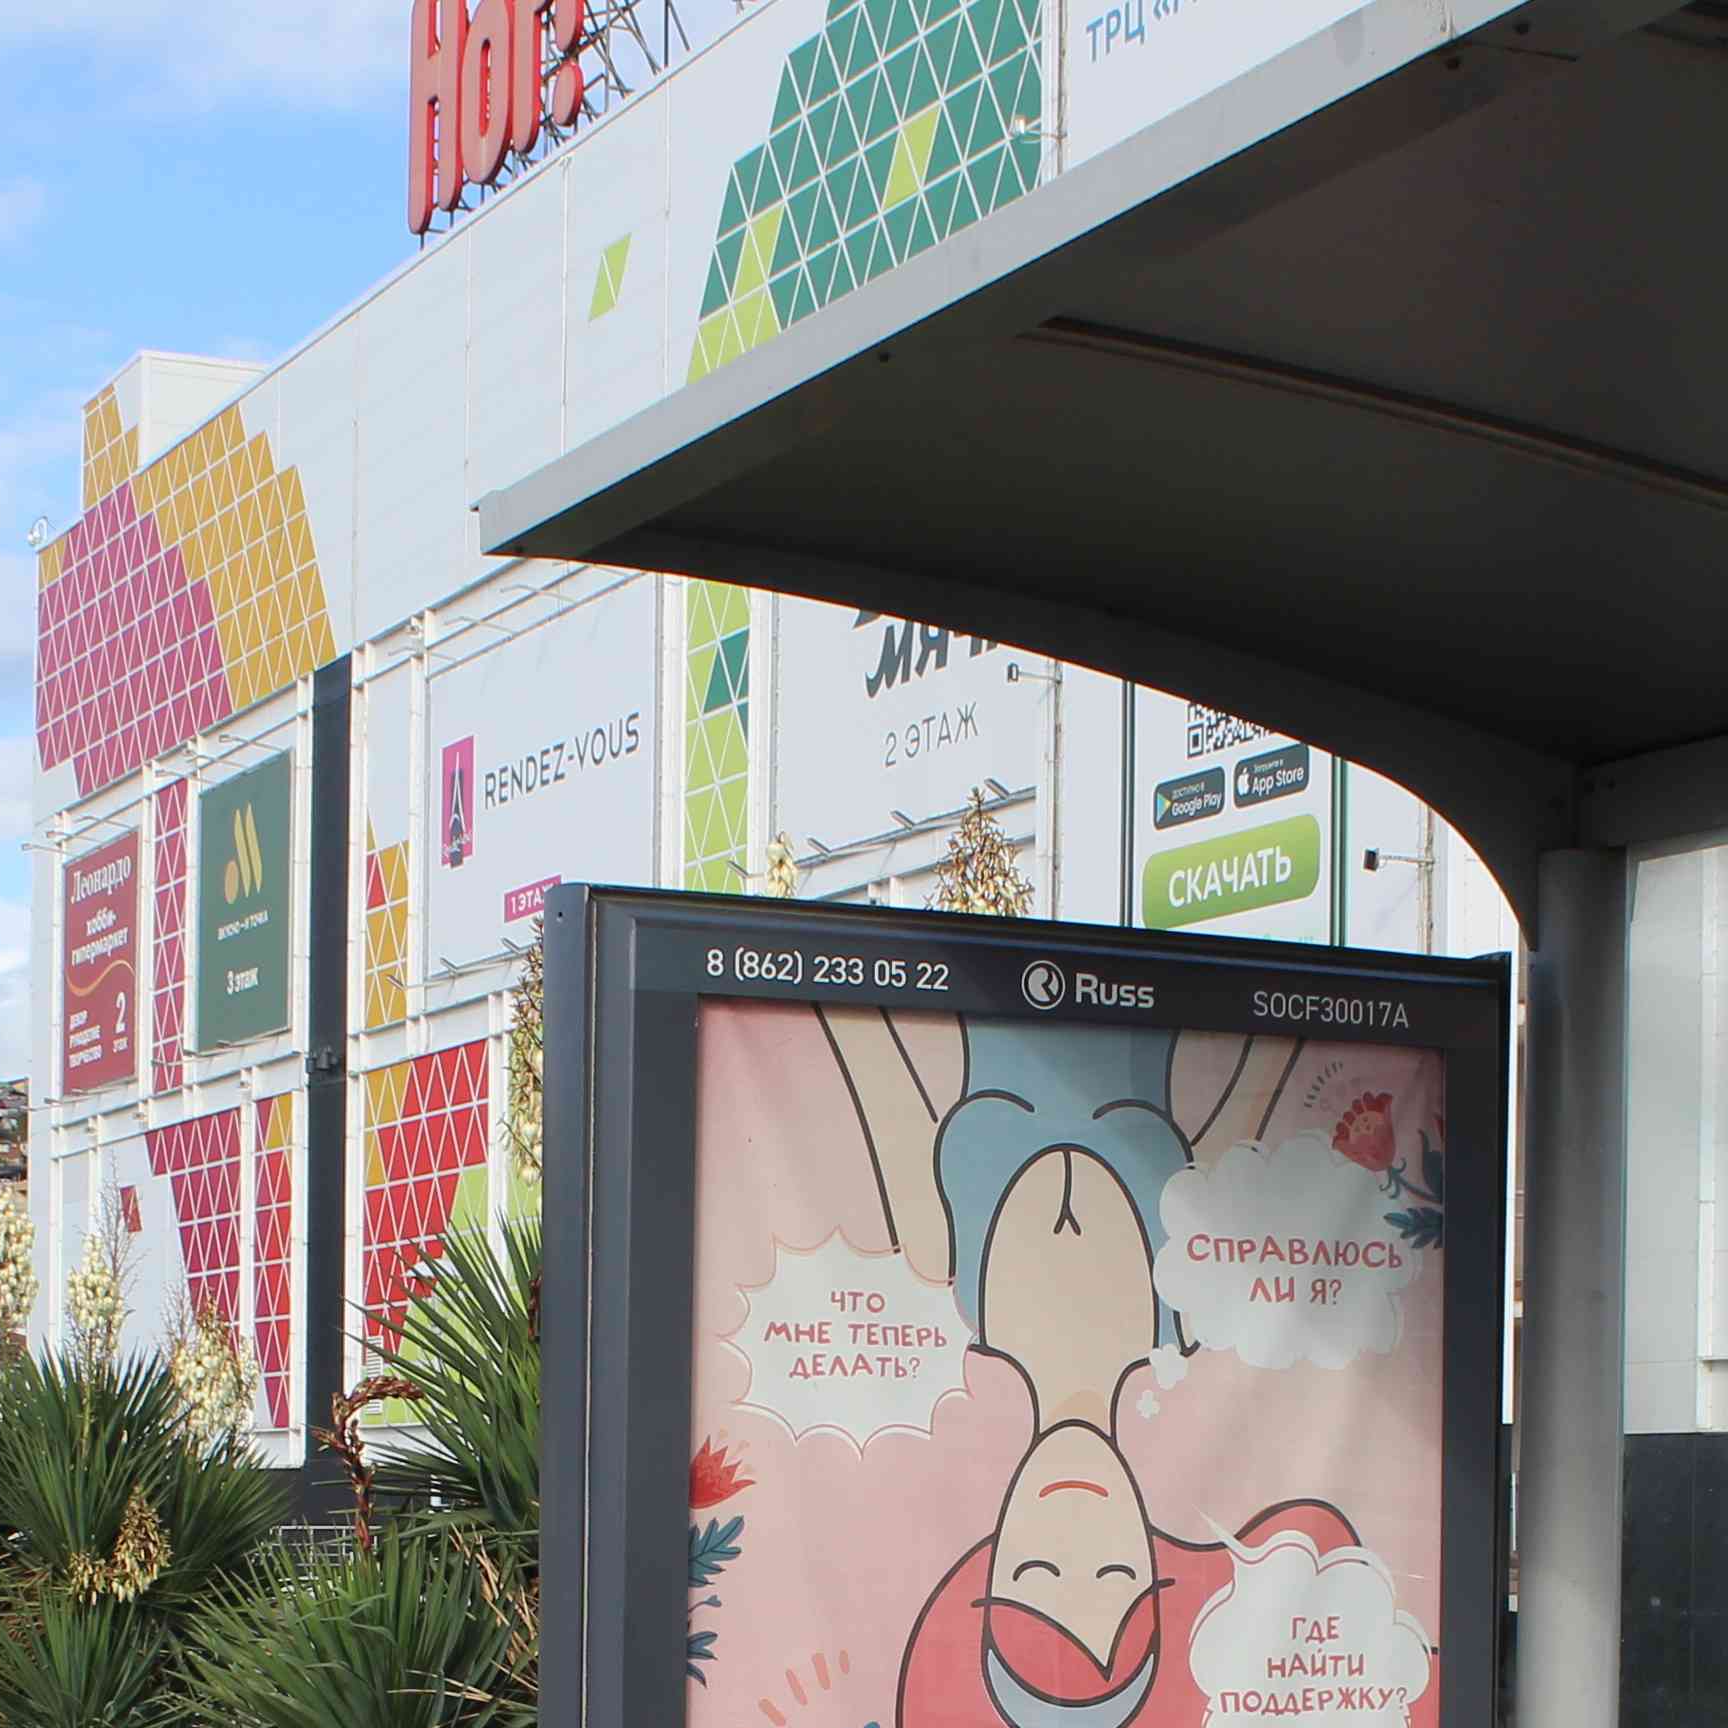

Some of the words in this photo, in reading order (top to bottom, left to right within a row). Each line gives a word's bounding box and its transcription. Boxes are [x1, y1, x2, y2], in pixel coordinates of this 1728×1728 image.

[885, 731, 897, 767] 2
[905, 701, 979, 758] ЭТАЖ
[484, 711, 640, 810] RENDEZ-VOUS
[1251, 776, 1273, 796] App
[1275, 766, 1304, 788] Store
[1172, 797, 1202, 817] Google
[1203, 792, 1222, 810] Play
[71, 856, 132, 904] Леонардо
[1169, 846, 1292, 908] СКАЧАТЬ
[706, 953, 724, 978] 8
[733, 949, 804, 986] (862)
[813, 956, 864, 986] 233
[873, 960, 907, 989] 05
[915, 962, 949, 991] 22
[1075, 973, 1155, 1008] Russ
[115, 991, 126, 1034] 2
[1252, 991, 1410, 1030] SOCF30017A
[1186, 1233, 1404, 1270] СПРАВЛЮСЬ
[830, 1291, 886, 1314] ЧТО
[1249, 1275, 1296, 1303] ЛИ
[1309, 1278, 1343, 1305] Я?
[763, 1321, 832, 1346] МНЕ
[848, 1322, 947, 1349] ТЕПЕРЬ
[789, 1353, 921, 1381] ДЕЛАТЬ?
[1291, 1616, 1341, 1644] ГДЕ
[1267, 1649, 1364, 1679] НАЙТИ
[1220, 1686, 1408, 1716] ПОДДЕРЖКУ?
